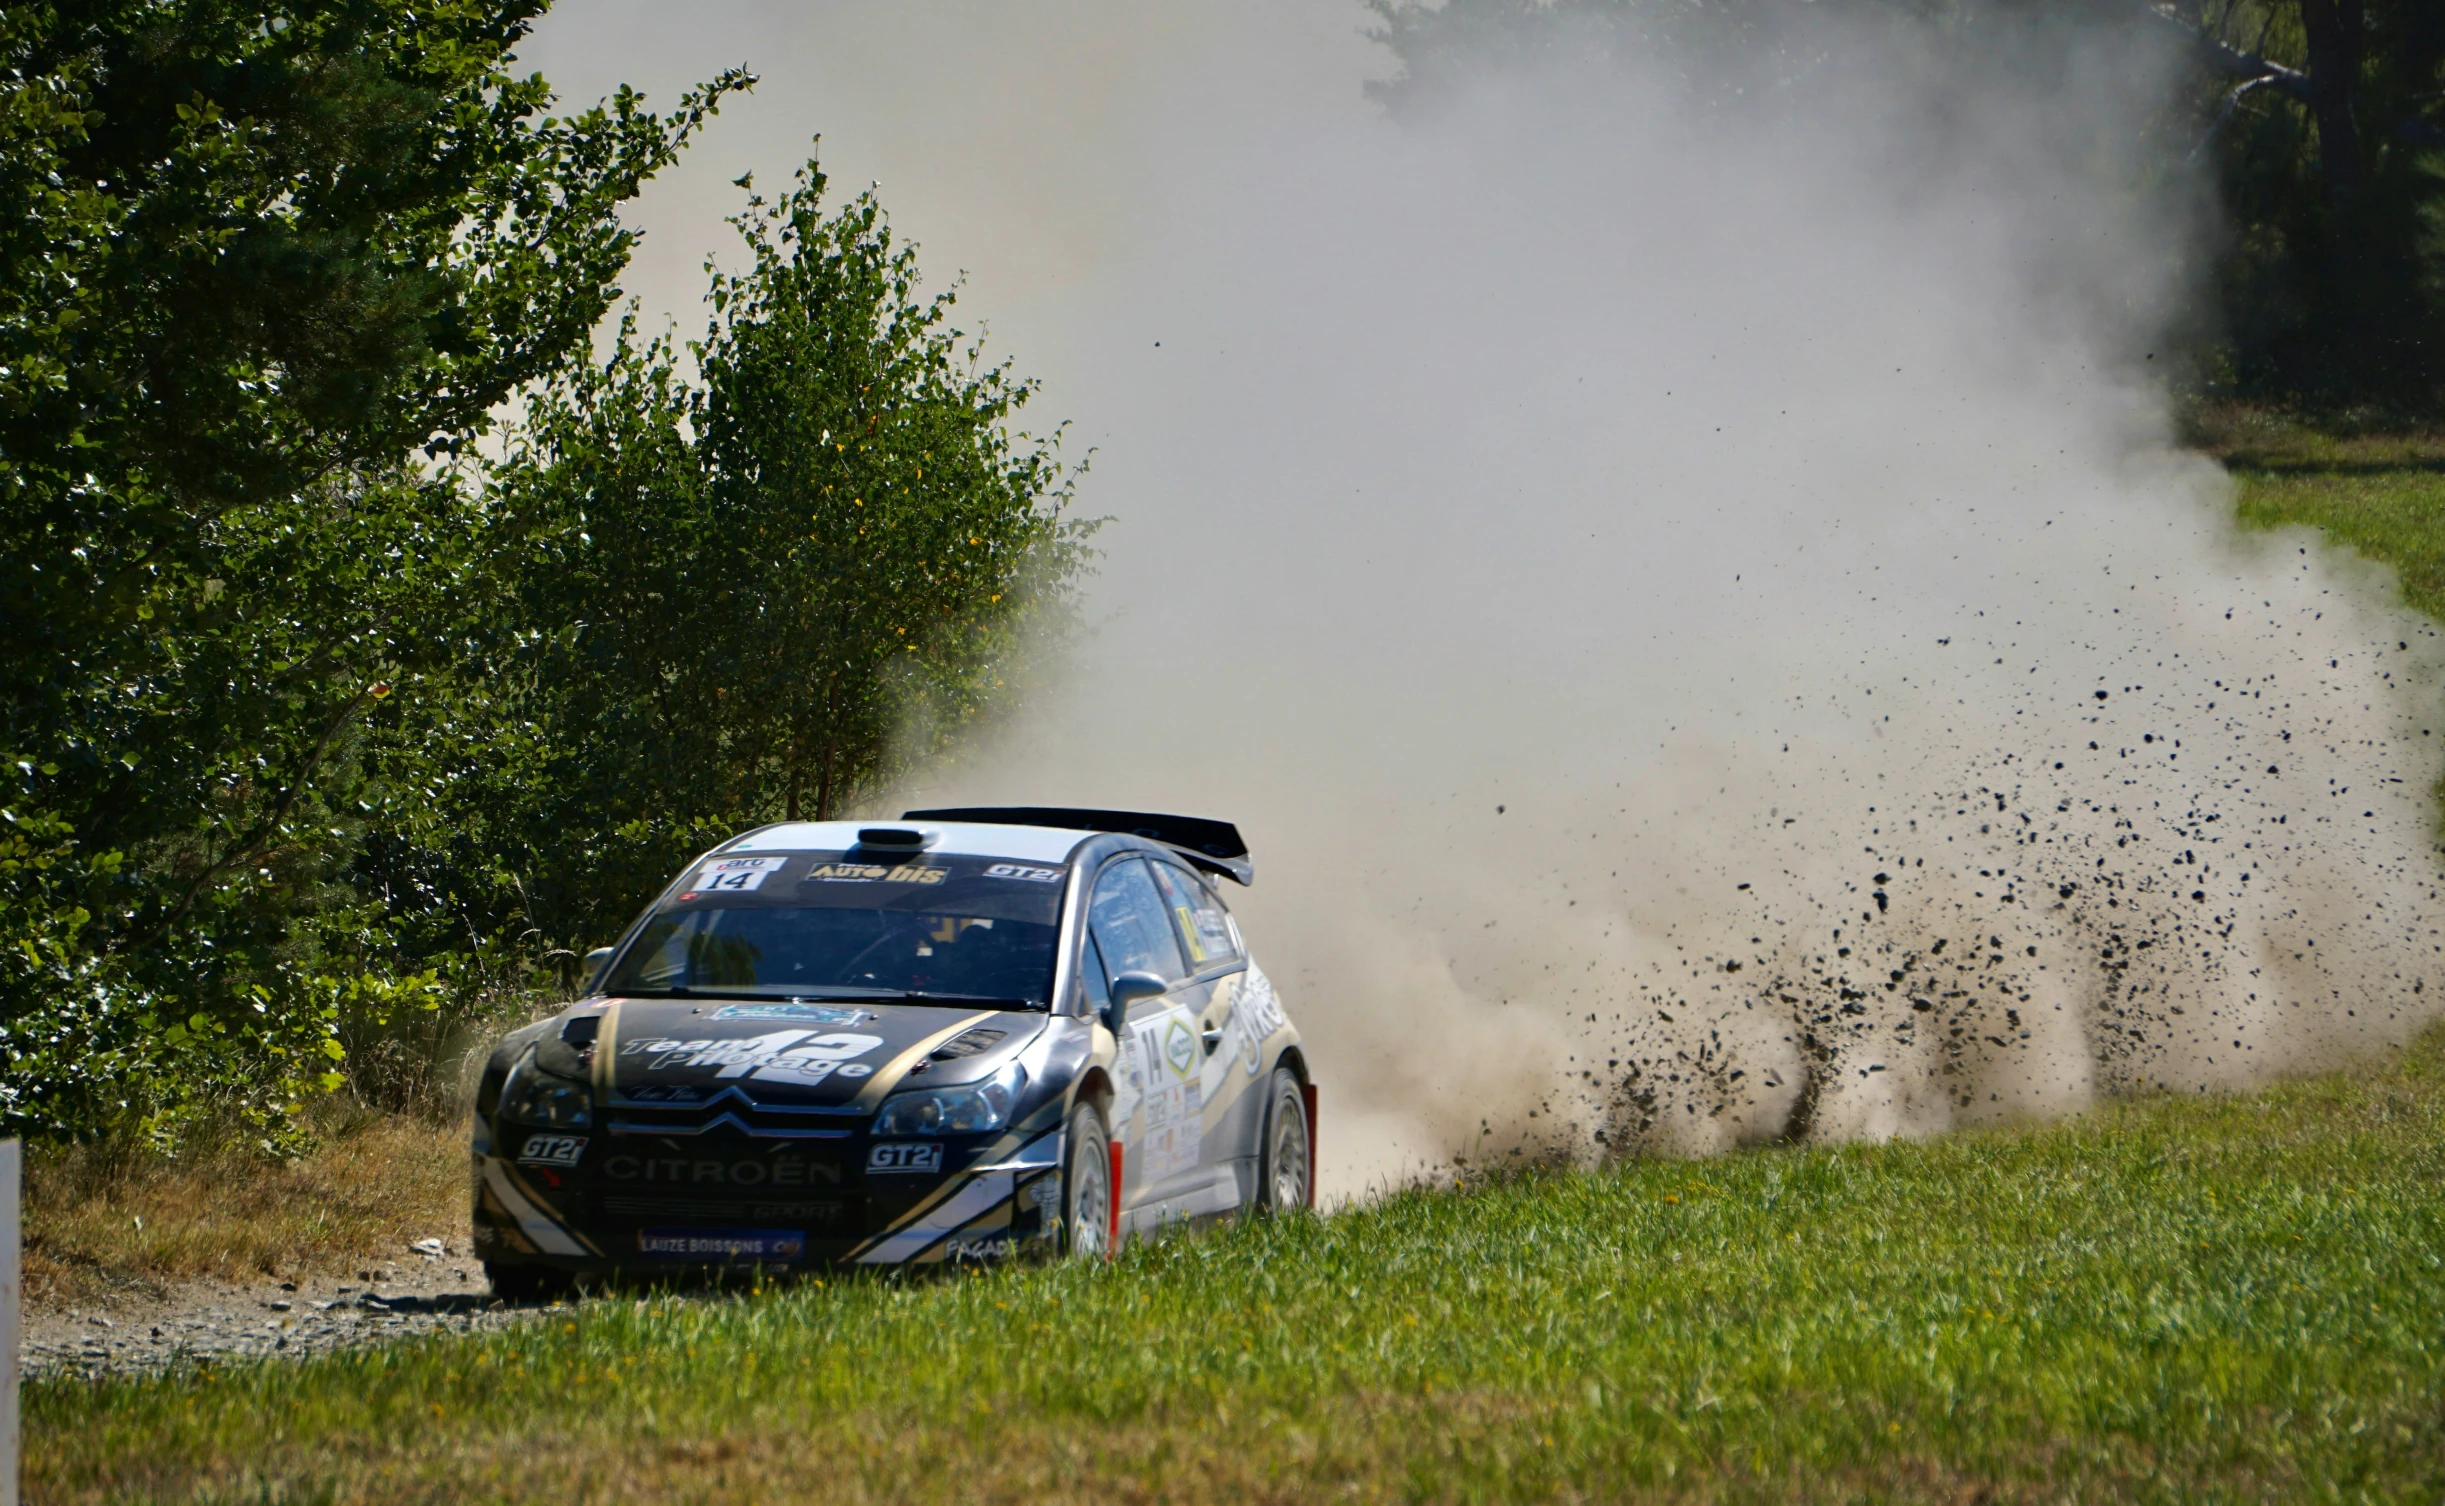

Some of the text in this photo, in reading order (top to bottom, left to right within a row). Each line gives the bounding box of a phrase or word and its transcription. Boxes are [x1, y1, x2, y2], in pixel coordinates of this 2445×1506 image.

[706, 872, 754, 890] 14
[885, 865, 946, 884] bis
[987, 864, 1064, 881] GT2i
[620, 1029, 885, 1087] Team 12
[648, 1050, 874, 1077] Pilotage
[1141, 1028, 1163, 1086] 14
[522, 1136, 586, 1160] GT2i
[870, 1143, 942, 1168] GT2i
[603, 1154, 842, 1185] CITROËN
[641, 1238, 686, 1253] LAUZE
[688, 1238, 764, 1254] BOISSONS
